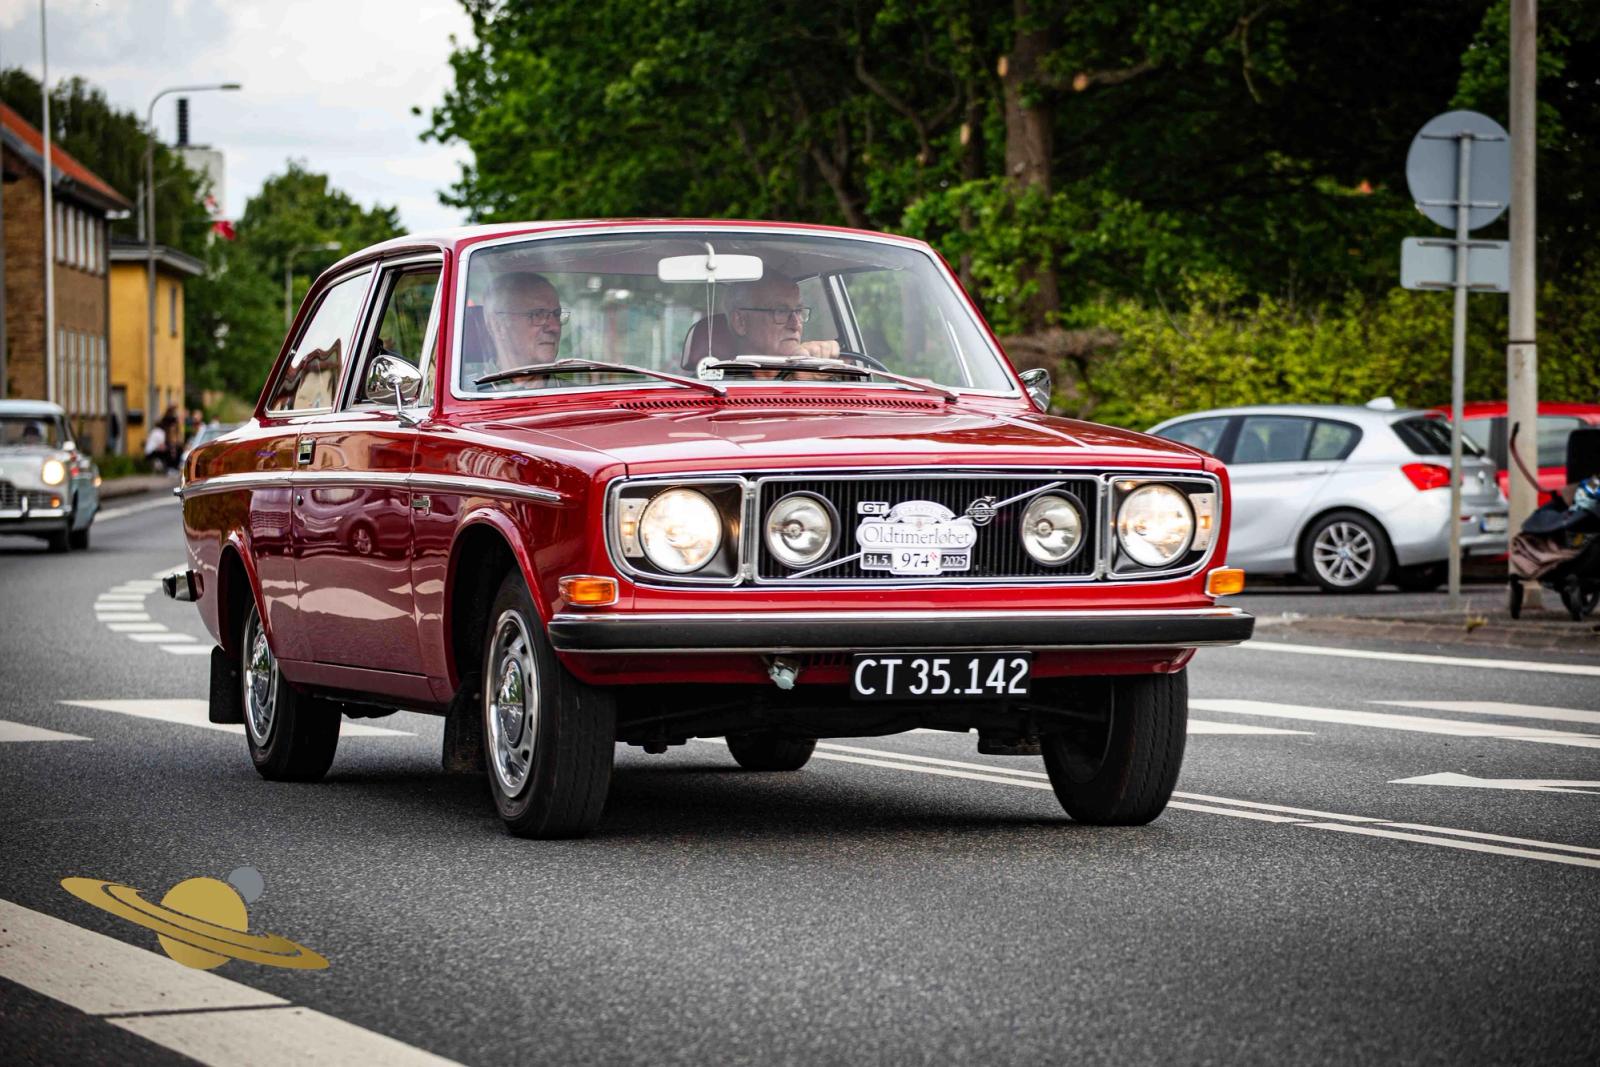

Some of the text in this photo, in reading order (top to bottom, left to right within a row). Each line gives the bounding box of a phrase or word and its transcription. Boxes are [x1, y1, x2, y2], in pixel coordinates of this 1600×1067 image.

[862, 503, 885, 512] GT
[901, 552, 930, 567] 974
[943, 555, 966, 567] 2025
[855, 658, 1029, 695] CT 35.142
